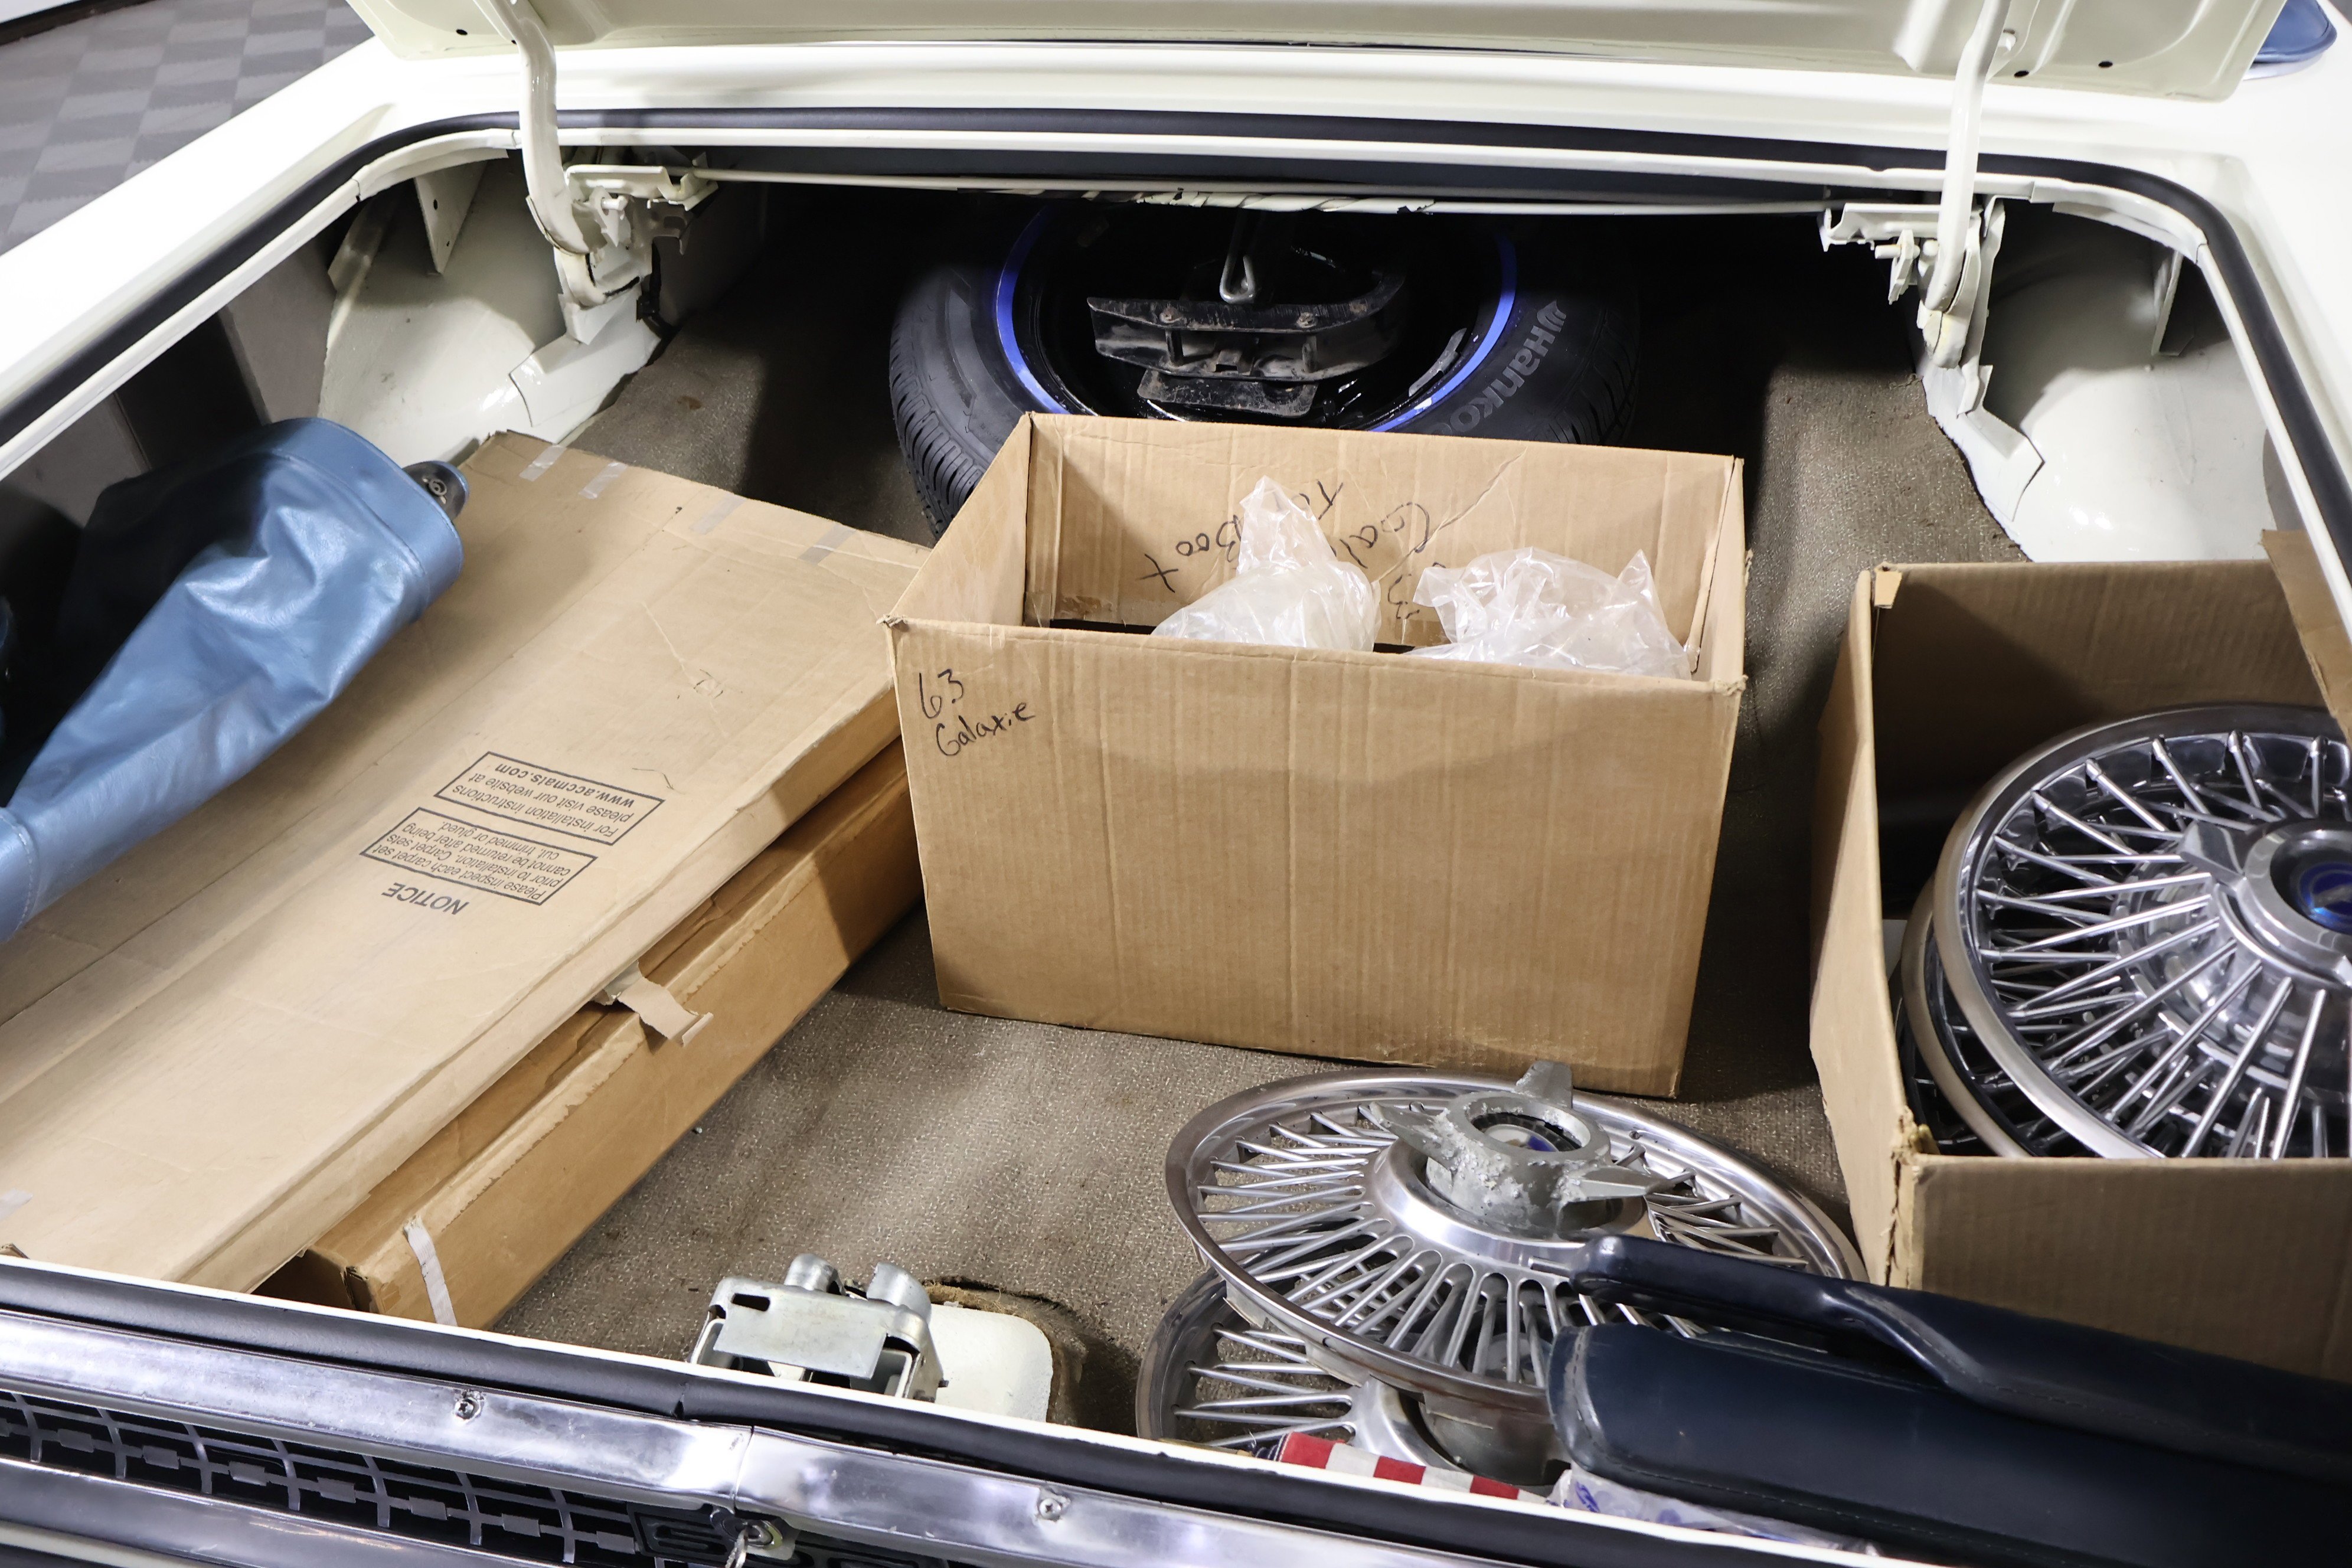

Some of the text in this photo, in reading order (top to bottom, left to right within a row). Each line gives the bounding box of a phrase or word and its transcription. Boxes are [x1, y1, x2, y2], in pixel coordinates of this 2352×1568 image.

[919, 668, 965, 720] 63
[936, 701, 1036, 756] Galaxie
[452, 784, 619, 838] For installation instructions
[467, 772, 635, 824] please visit our website at
[494, 763, 635, 809] www.accmats.com
[401, 822, 571, 877] cannot be returned after being
[437, 821, 478, 839] glued.
[472, 832, 489, 842] or
[484, 838, 536, 857] trimmed
[372, 844, 547, 900] Please inspect each carpet set
[386, 834, 564, 888] prior to installation. Carpet sets
[381, 882, 470, 916] NOTICE
